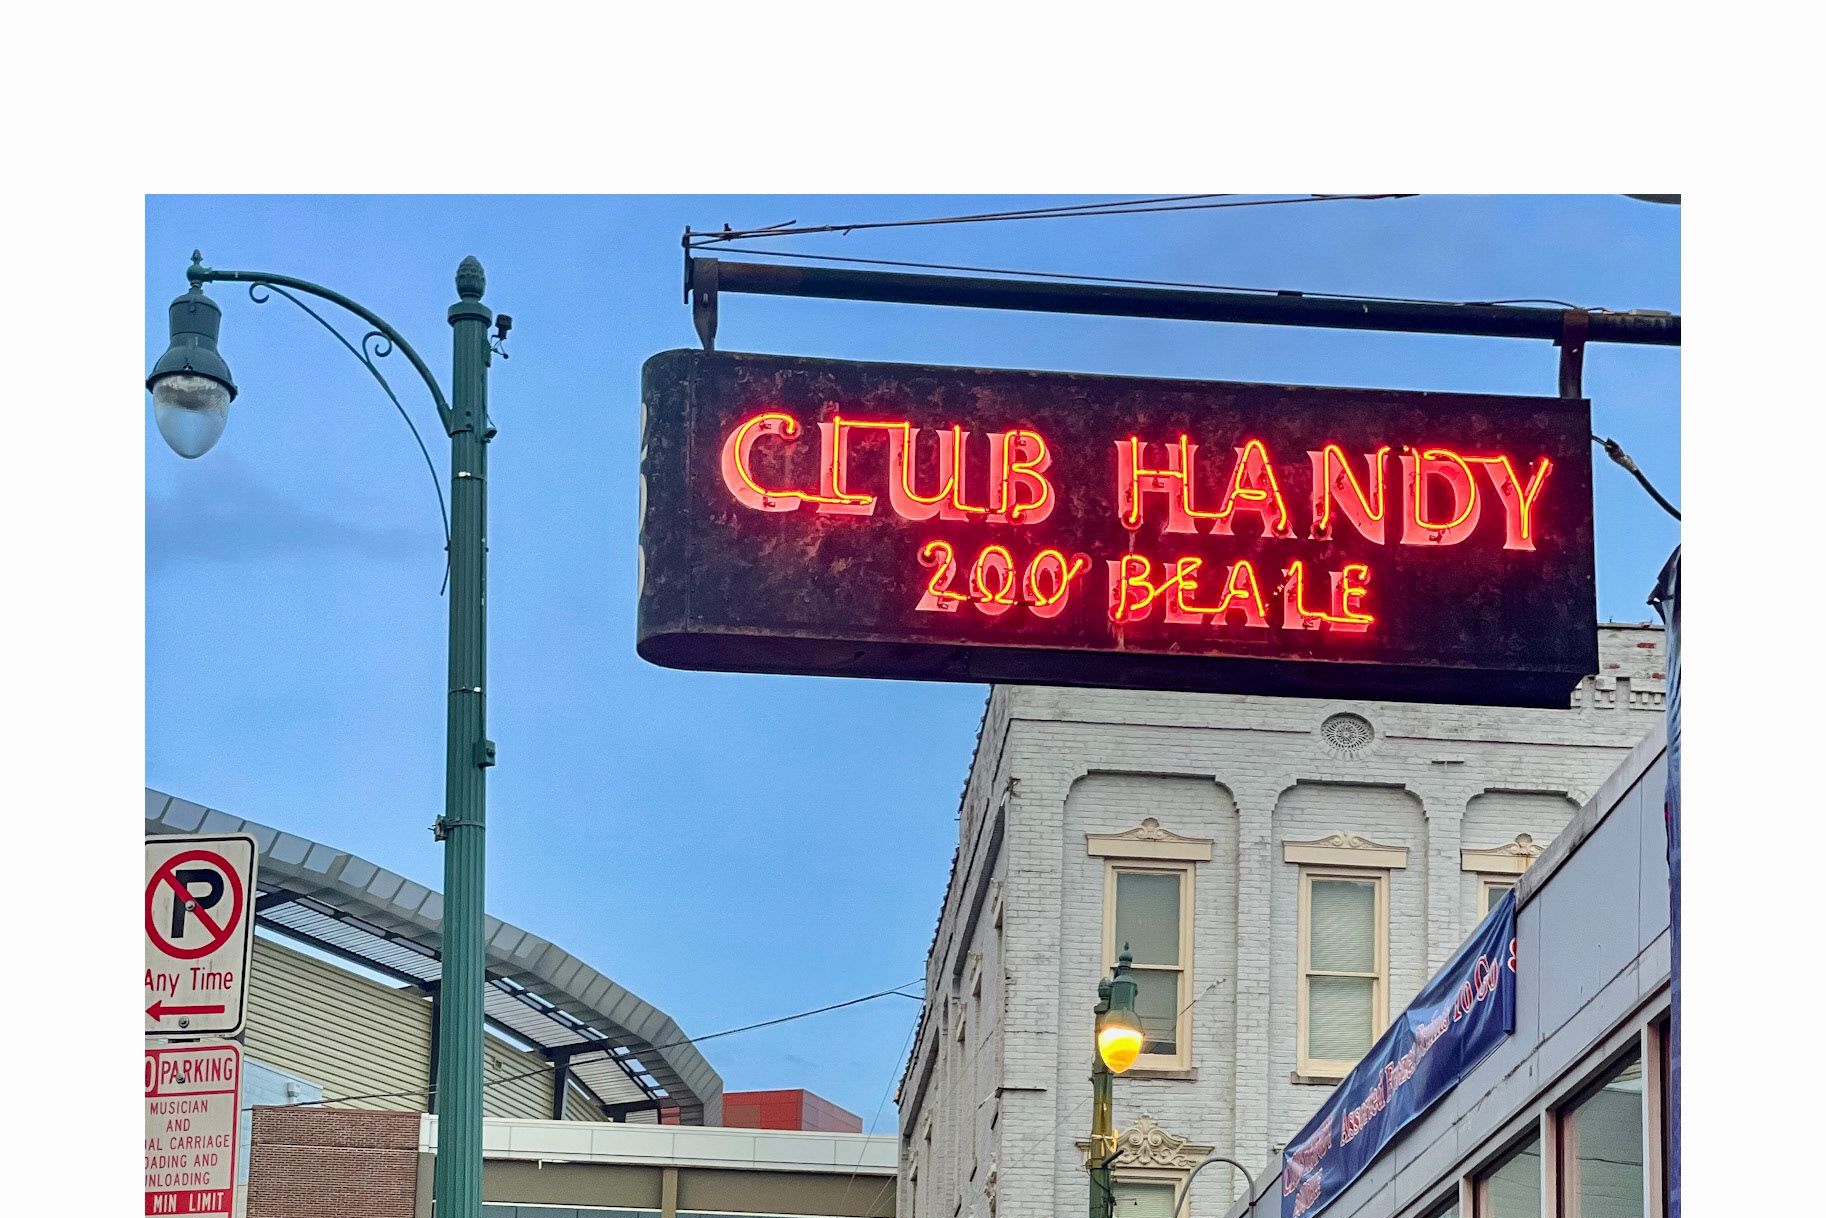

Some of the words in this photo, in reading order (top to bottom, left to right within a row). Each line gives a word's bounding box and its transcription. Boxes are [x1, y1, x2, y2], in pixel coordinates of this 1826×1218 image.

[721, 413, 1056, 525] CLUB
[1113, 434, 1552, 551] HANDY
[917, 539, 1088, 619] 200
[1106, 555, 1375, 632] BEALE
[145, 968, 180, 998] Any
[190, 967, 233, 991] Time
[161, 1057, 233, 1085] PARKING
[150, 1099, 208, 1116] MUSICIAN
[166, 1118, 191, 1132] AND
[170, 1134, 230, 1150] CARRIAGE
[193, 1153, 218, 1167] AND
[153, 1193, 177, 1213] MIN
[189, 1192, 225, 1212] LIMIT
